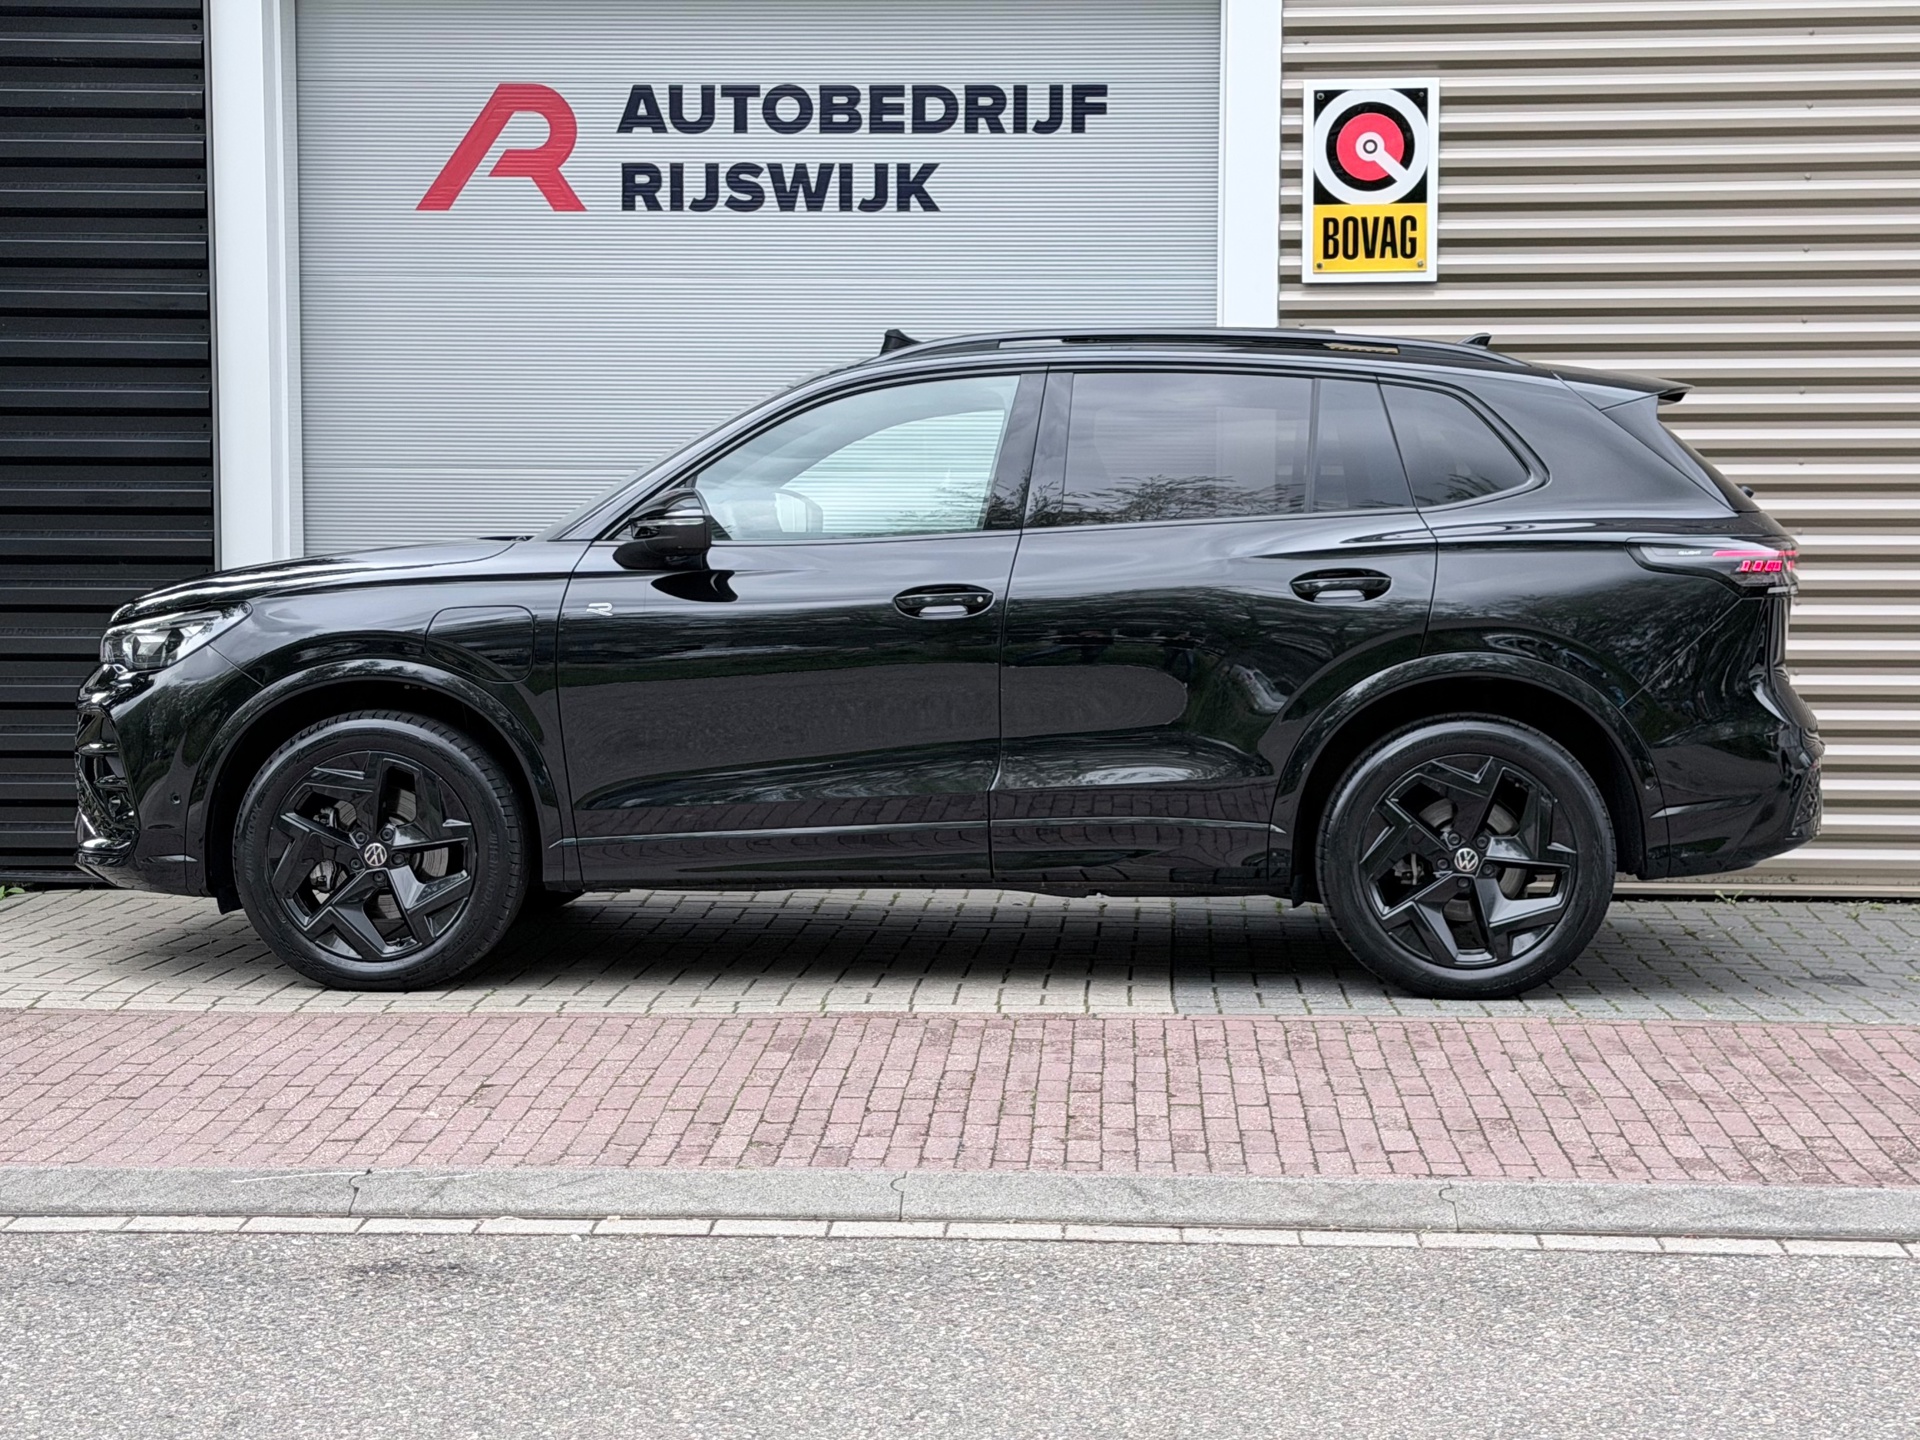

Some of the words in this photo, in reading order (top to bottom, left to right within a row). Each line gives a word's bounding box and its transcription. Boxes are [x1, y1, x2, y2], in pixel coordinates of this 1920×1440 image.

[617, 84, 1107, 134] AUTOBEDRIJF
[622, 163, 940, 213] RIJSWIJK
[1322, 215, 1417, 260] BOVAG
